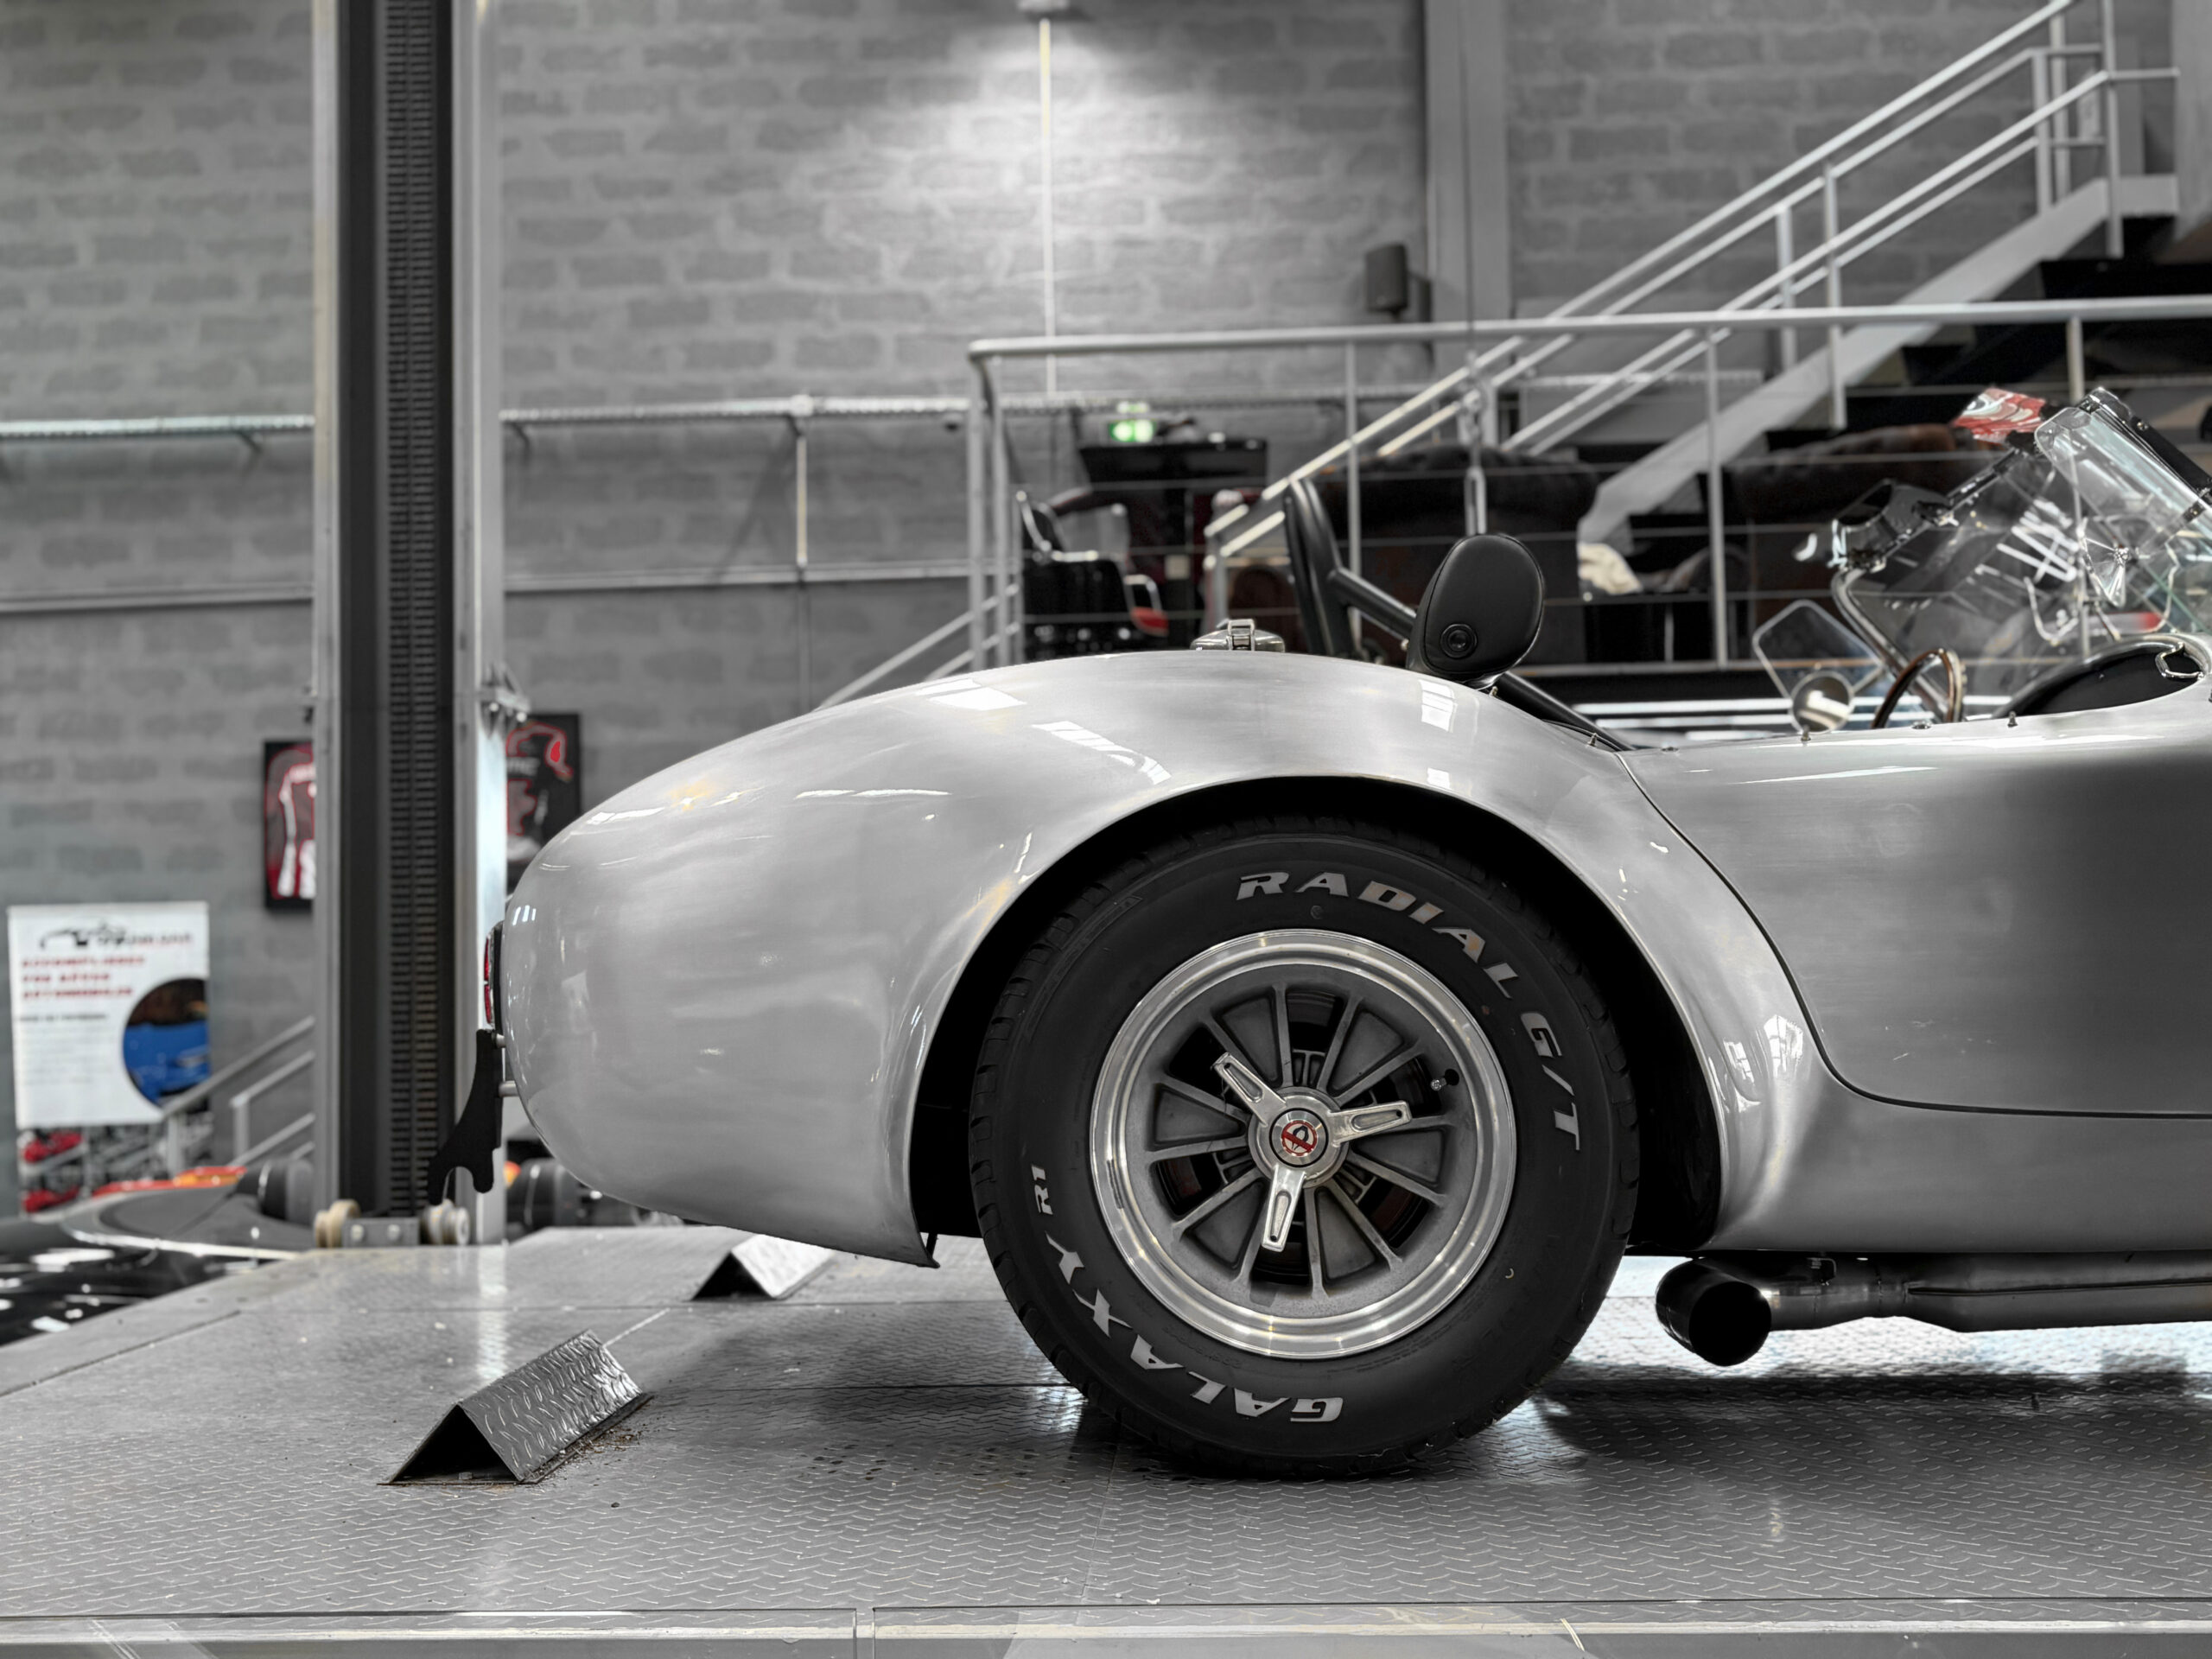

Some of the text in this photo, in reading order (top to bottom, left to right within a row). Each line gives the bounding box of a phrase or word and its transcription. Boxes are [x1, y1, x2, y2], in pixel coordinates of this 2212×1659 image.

[1236, 871, 1519, 999] RADIAL
[1521, 1012, 1581, 1151] G/T
[1046, 1231, 1344, 1423] GALAXY
